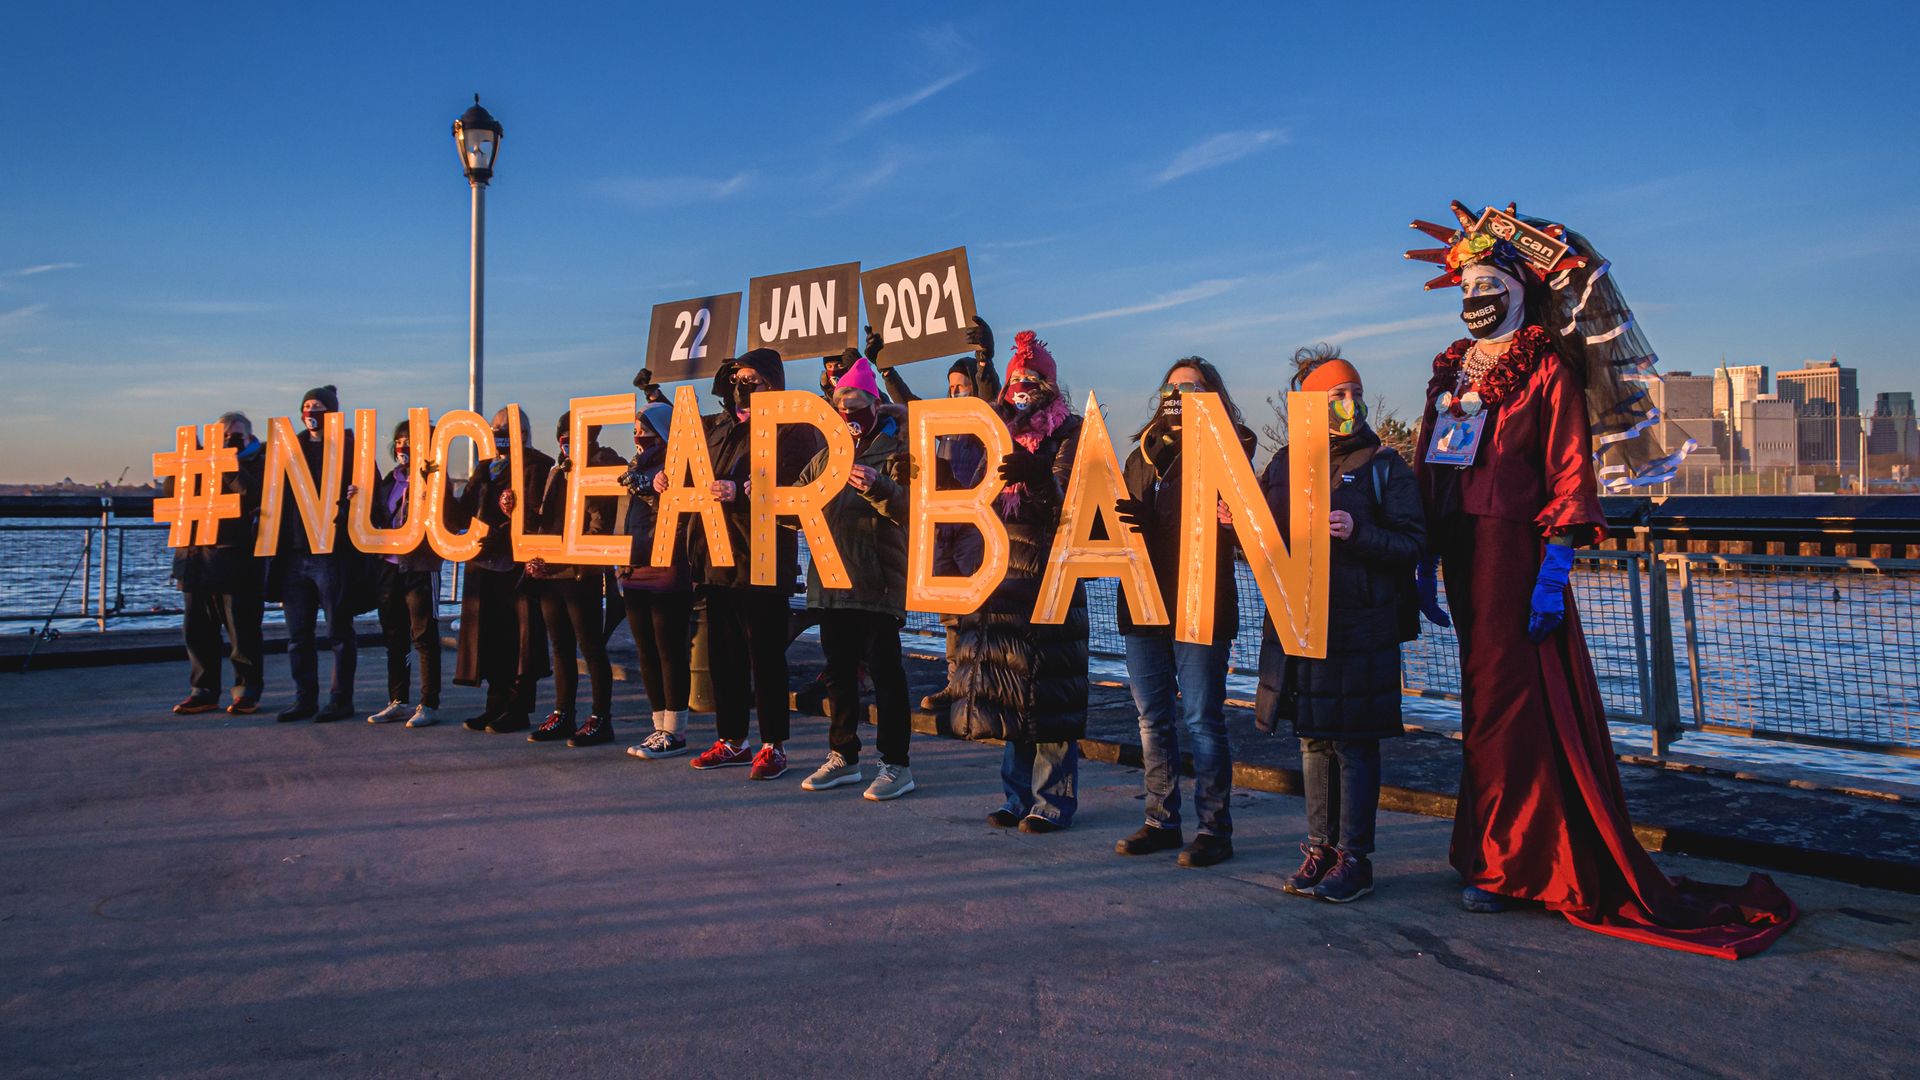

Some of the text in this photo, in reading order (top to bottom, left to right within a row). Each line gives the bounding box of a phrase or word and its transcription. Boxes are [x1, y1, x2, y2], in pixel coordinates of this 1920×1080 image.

[670, 308, 712, 361] 22
[759, 279, 847, 343] JAN.
[876, 266, 967, 344] 2021
